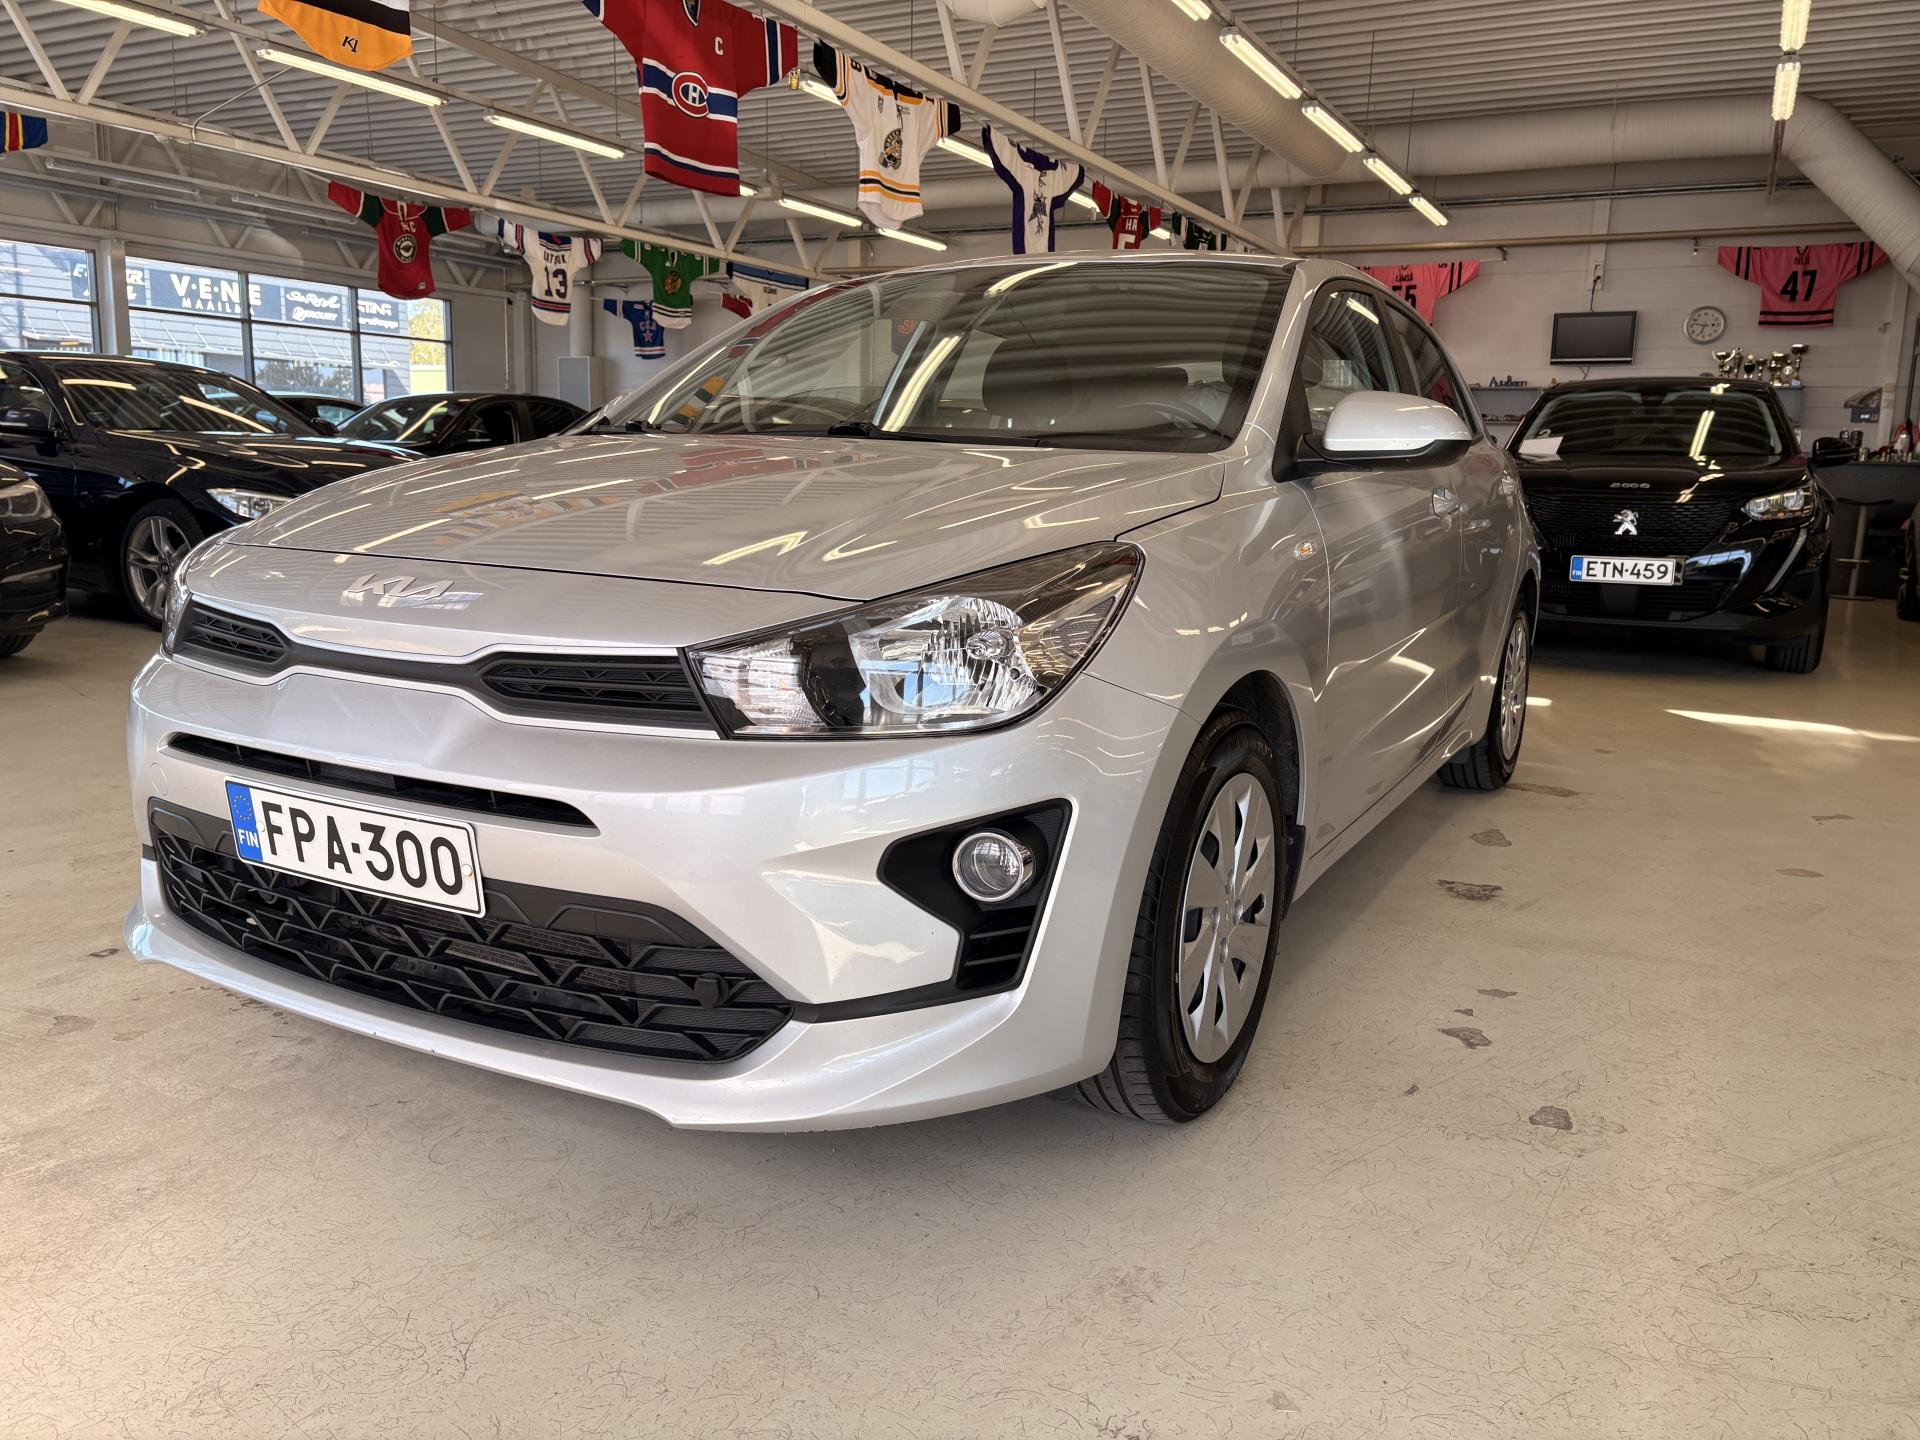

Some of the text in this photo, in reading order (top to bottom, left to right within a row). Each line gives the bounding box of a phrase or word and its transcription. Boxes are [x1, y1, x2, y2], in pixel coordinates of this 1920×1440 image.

[714, 36, 724, 56] C
[544, 265, 568, 299] 13
[1780, 269, 1817, 303] 47
[347, 572, 455, 600] KIA
[1586, 561, 1669, 580] ETN-459
[238, 800, 463, 896] FIN FPA-300
